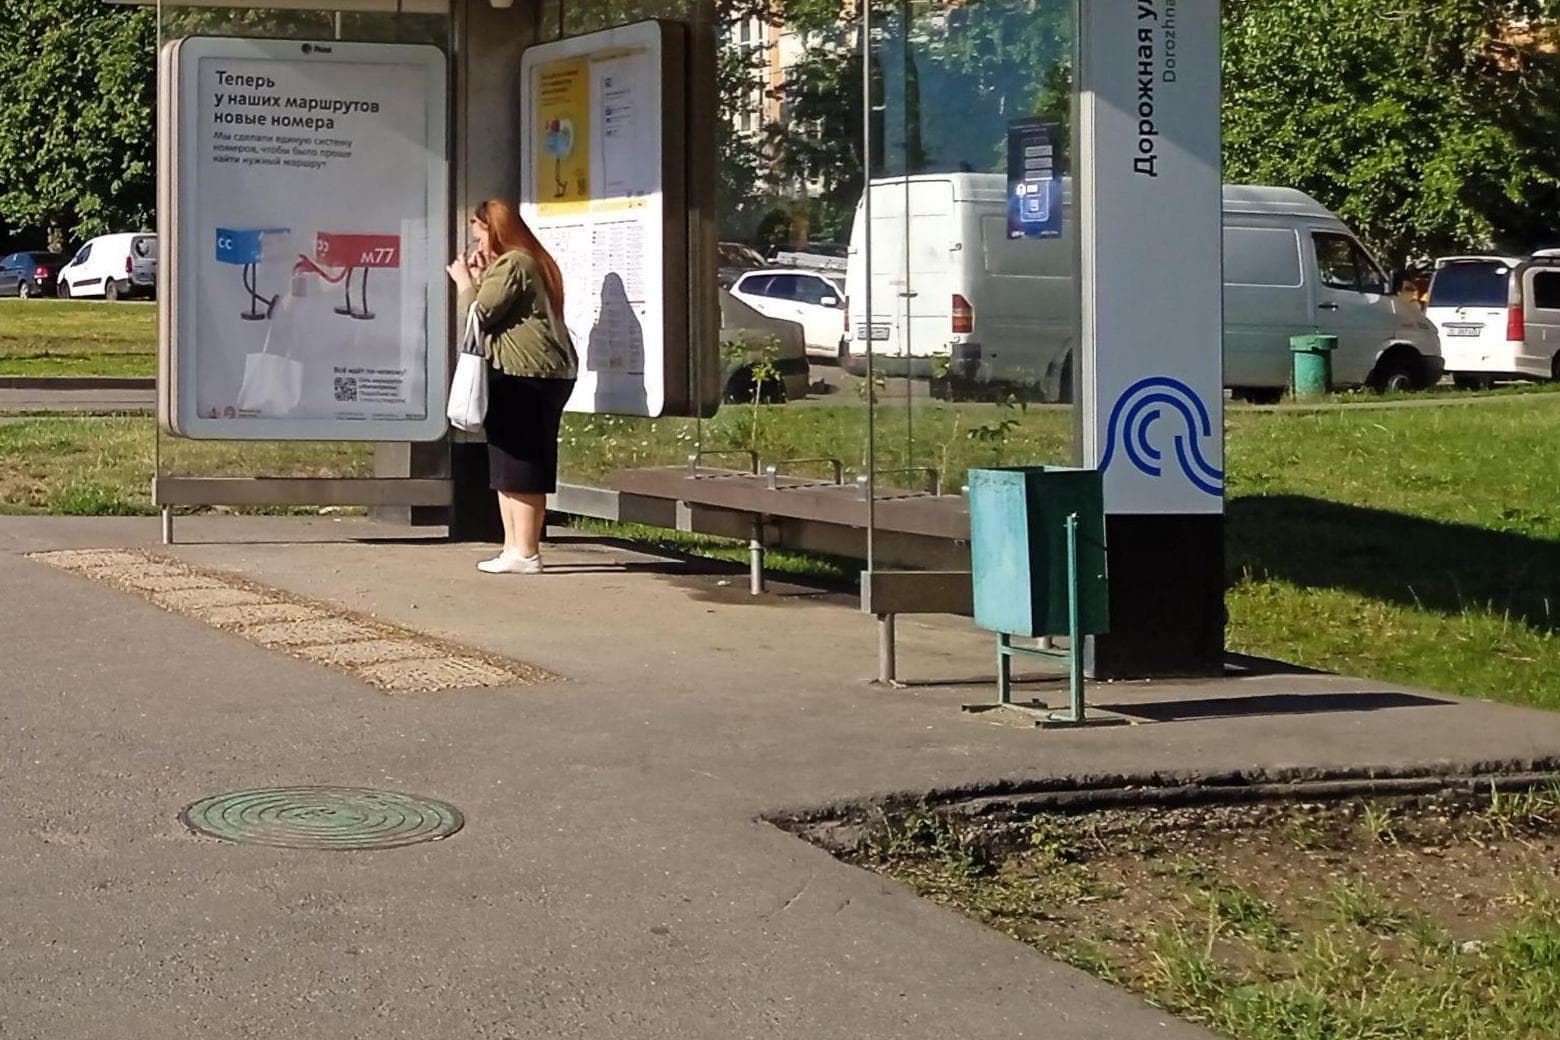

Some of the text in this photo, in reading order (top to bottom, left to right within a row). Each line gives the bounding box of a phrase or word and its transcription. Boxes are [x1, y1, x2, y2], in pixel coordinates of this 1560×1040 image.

[216, 70, 276, 91] Теперь
[214, 92, 380, 115] у наших маршрутов
[1133, 28, 1159, 178] Дорожная
[213, 111, 335, 132] новые номера
[213, 131, 232, 141] Мы
[260, 145, 290, 155] чтобы
[292, 146, 318, 157] было
